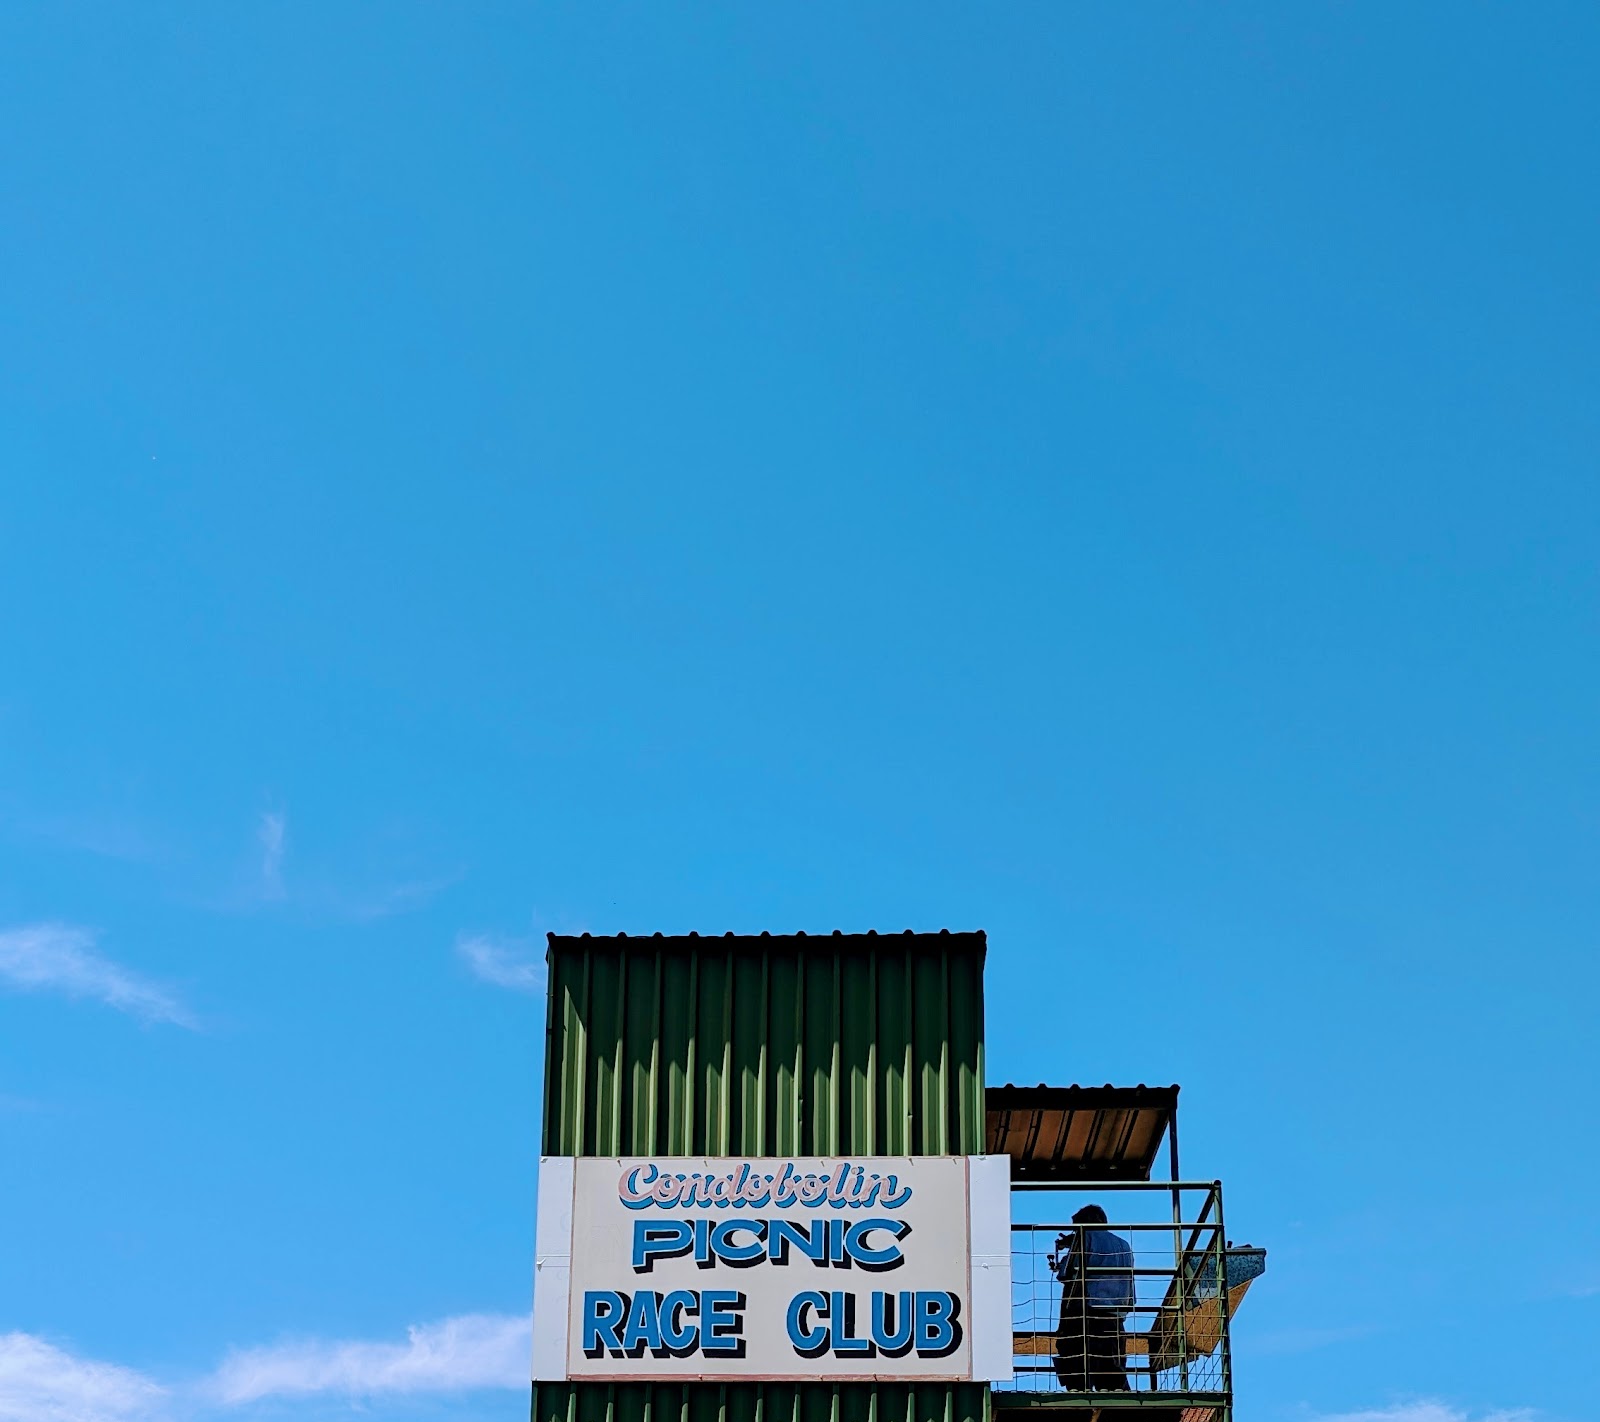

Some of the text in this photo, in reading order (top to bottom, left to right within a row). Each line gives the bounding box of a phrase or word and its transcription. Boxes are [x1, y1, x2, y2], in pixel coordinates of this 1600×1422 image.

[618, 1162, 913, 1211] Condobolin
[631, 1218, 913, 1274] PICNIC
[582, 1290, 963, 1359] RACE CLUB
